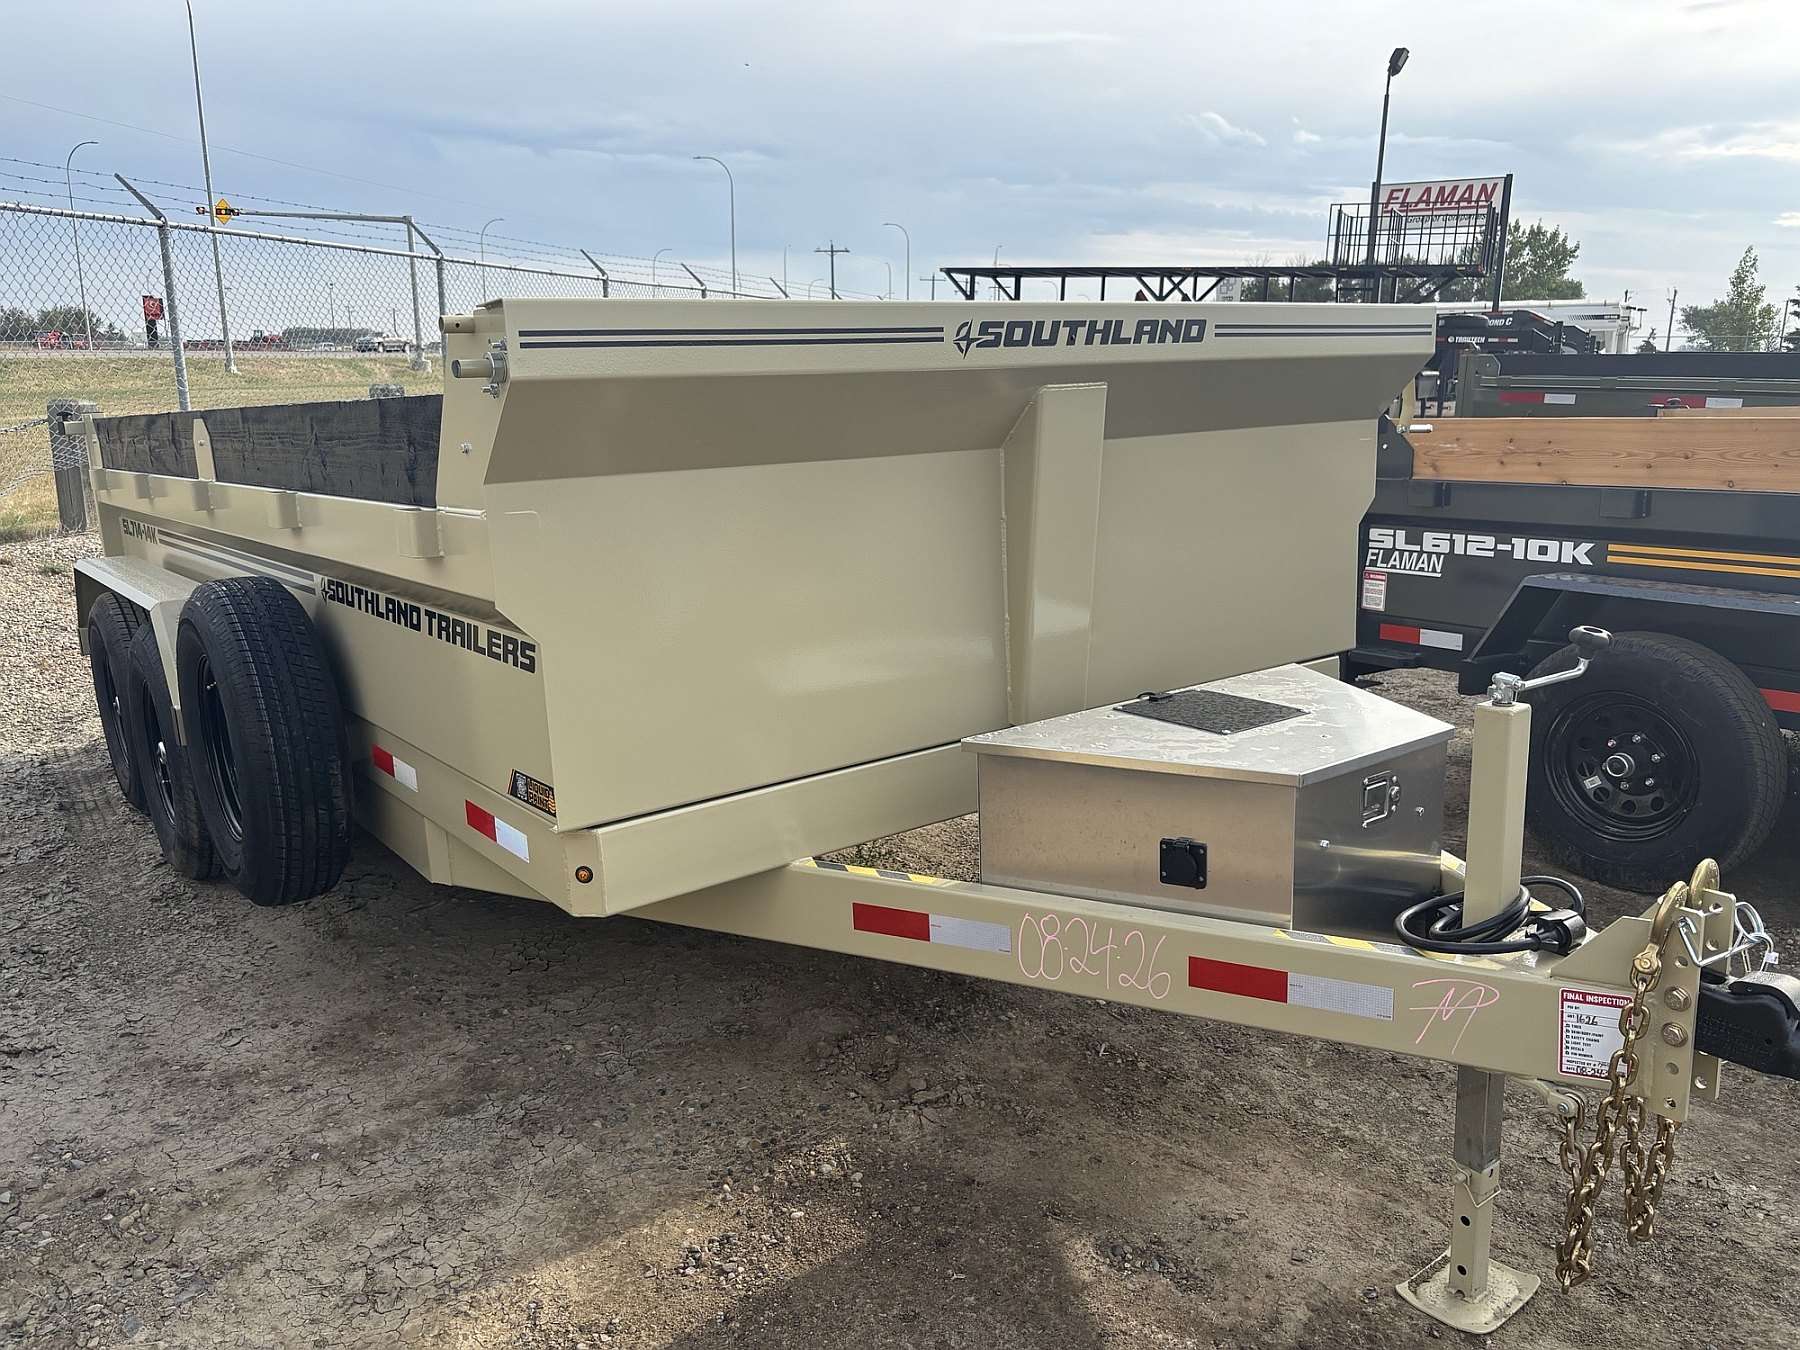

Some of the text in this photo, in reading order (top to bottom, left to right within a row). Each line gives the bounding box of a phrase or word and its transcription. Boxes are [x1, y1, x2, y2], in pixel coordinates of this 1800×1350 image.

[1384, 182, 1498, 209] FLAMAN
[975, 319, 1207, 348] SOUTHLAND
[1505, 317, 1513, 326] C
[1368, 528, 1596, 566] SL612-10K
[1366, 549, 1445, 573] FLAMAN
[327, 579, 536, 674] SOUTHLAND TRAILERS
[1563, 992, 1630, 1007] FINAL INSPECTION
